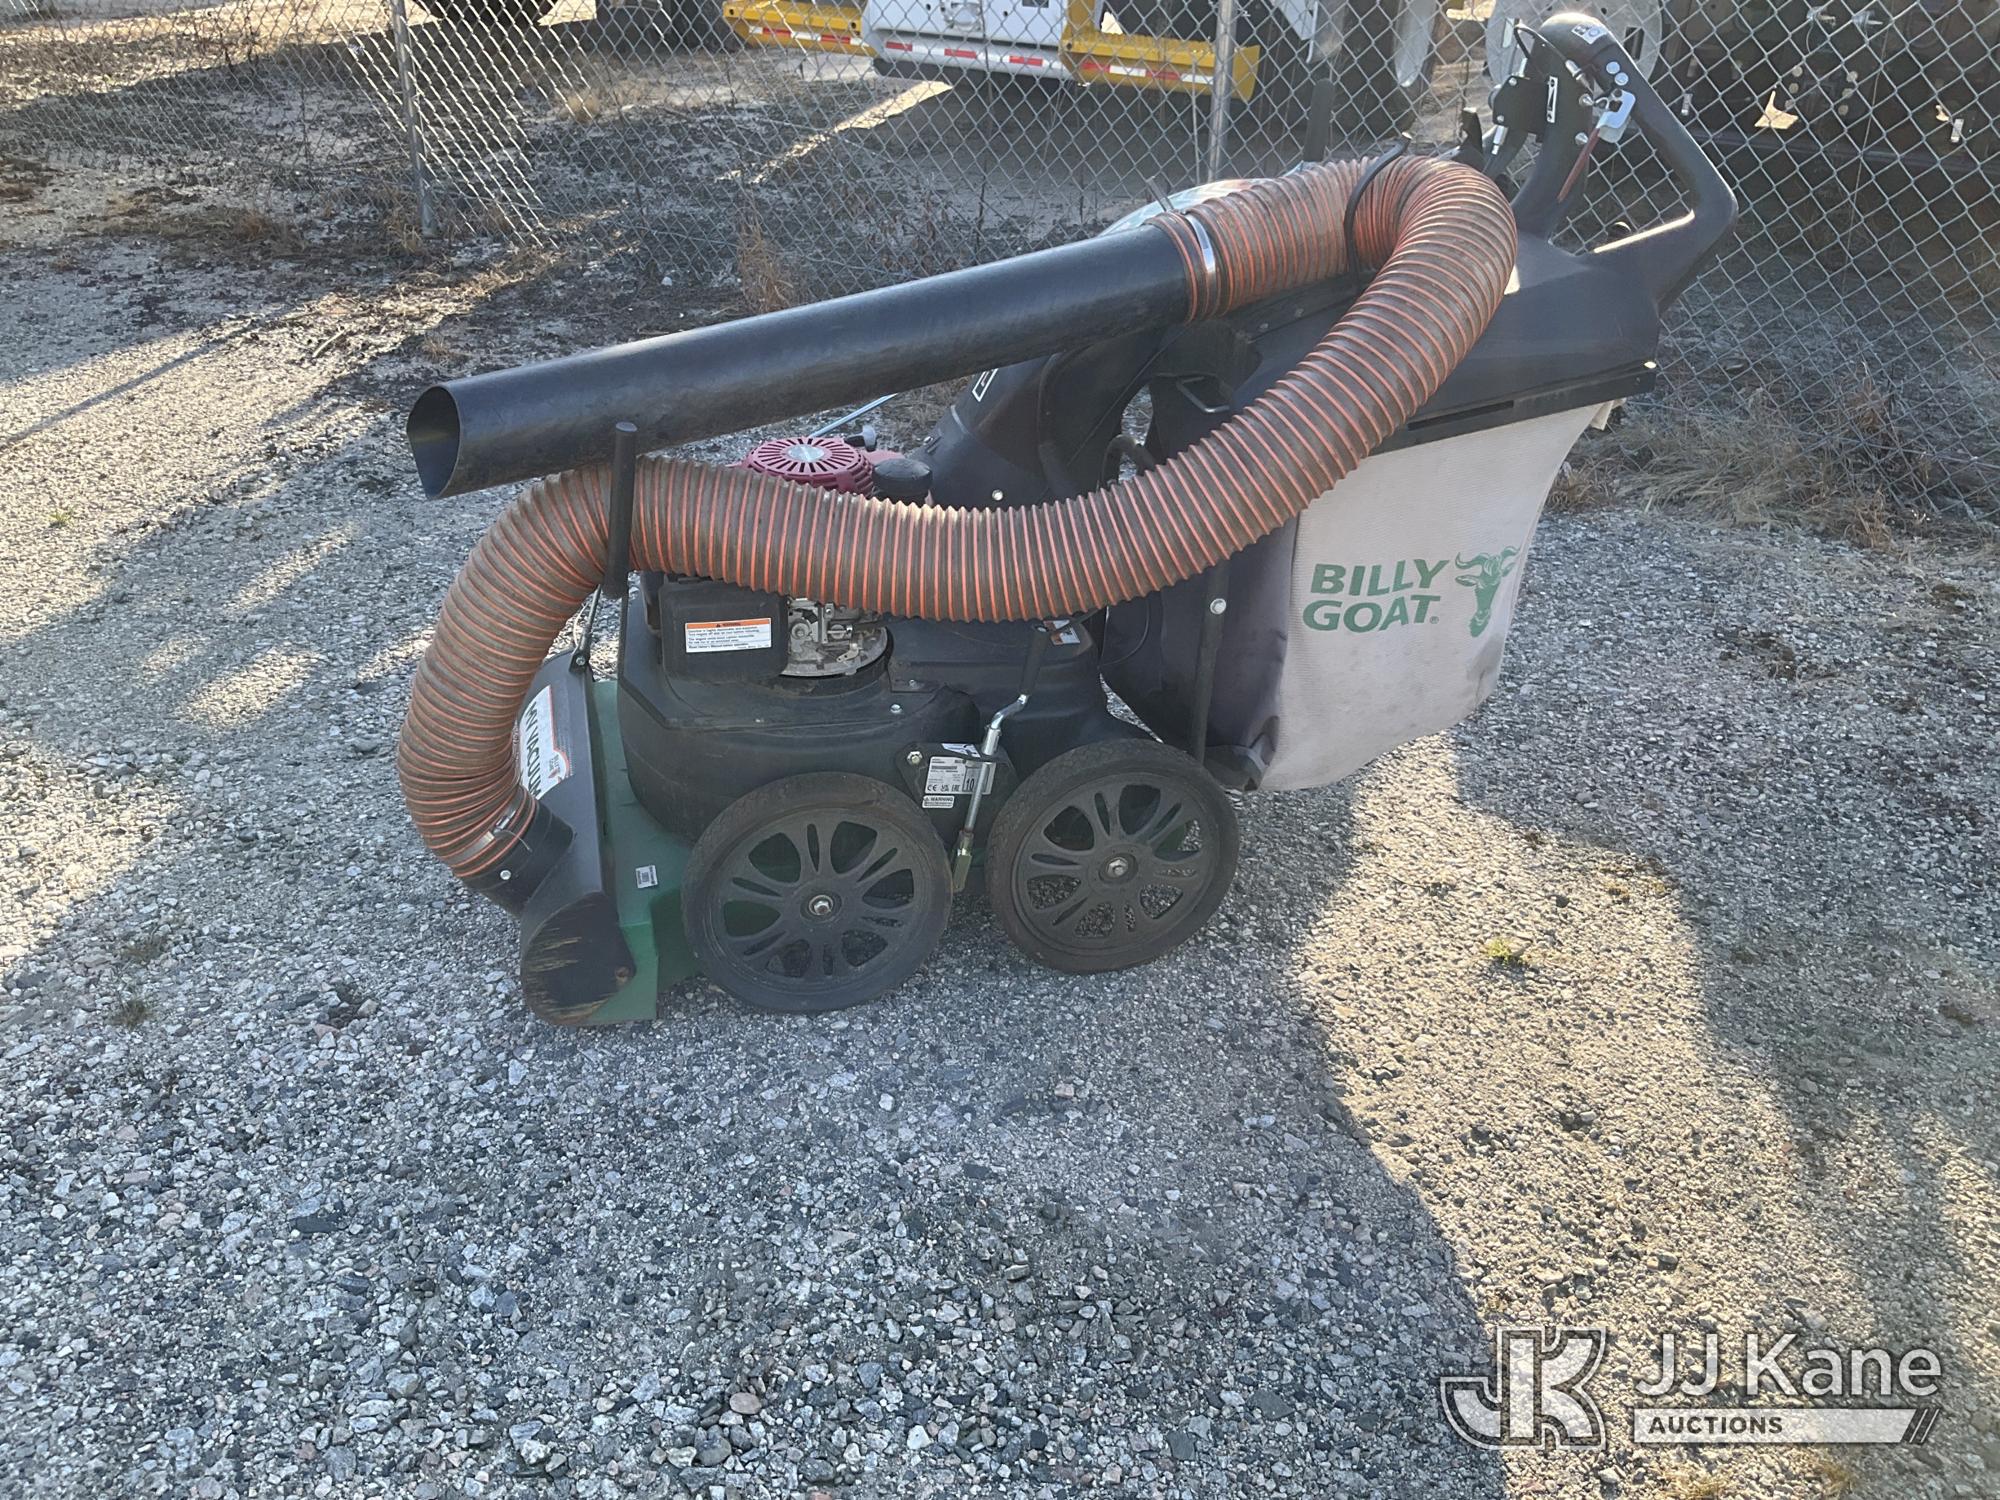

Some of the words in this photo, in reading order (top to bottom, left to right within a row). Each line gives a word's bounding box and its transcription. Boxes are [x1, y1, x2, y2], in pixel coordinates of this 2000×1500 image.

[1310, 558, 1450, 596] BILLY
[1302, 595, 1442, 633] GOAT
[526, 726, 542, 797] VACUUM
